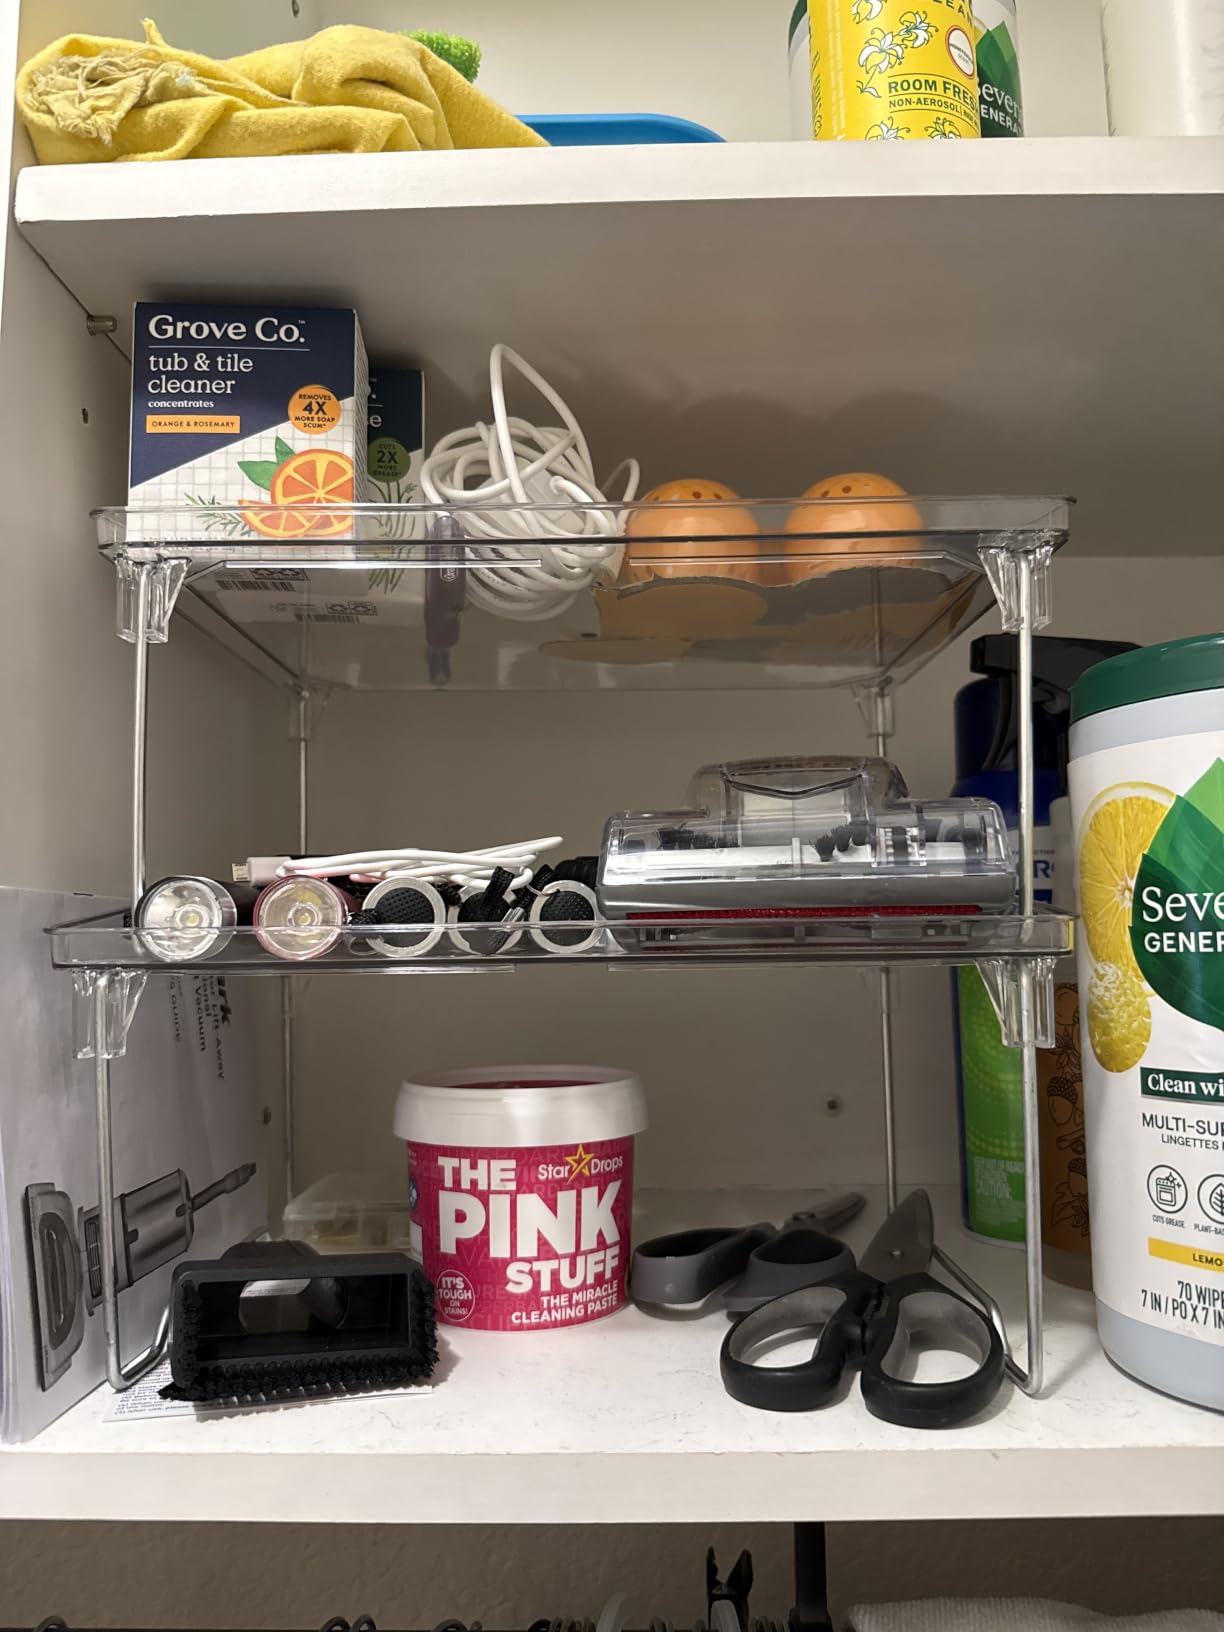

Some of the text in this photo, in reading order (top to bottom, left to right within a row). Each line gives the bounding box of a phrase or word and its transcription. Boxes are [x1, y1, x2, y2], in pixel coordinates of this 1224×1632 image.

[888, 79, 978, 113] ROOM FRES
[889, 98, 960, 113] NON-AEROSOL
[978, 77, 1021, 119] even
[981, 105, 1022, 136] ENERA
[149, 314, 247, 341] Grove
[149, 353, 254, 372] tub & tile
[148, 375, 236, 394] cleaner
[148, 400, 215, 408] concentrates
[298, 393, 332, 401] REMOVES
[302, 401, 328, 415] 4X
[376, 450, 399, 464] 2X
[1147, 1073, 1197, 1094] Clean
[1161, 1133, 1219, 1150] LINGETTES
[437, 1156, 517, 1191] THE
[538, 1156, 623, 1180] Star Drops
[438, 1180, 622, 1258] PINK
[1166, 1217, 1185, 1229] GREASE
[505, 1245, 620, 1294] STUFF
[1192, 1252, 1223, 1267] LEMO
[441, 1277, 464, 1289] IT'S
[1177, 1280, 1192, 1301] 70
[439, 1289, 472, 1300] TOUGH
[541, 1280, 618, 1308] THE MIRACLE
[511, 1305, 584, 1324] CLEANING
[587, 1293, 618, 1314] PASTE
[1141, 1289, 1148, 1307] 7
[1150, 1292, 1162, 1312] IN
[1171, 1298, 1188, 1320] PO
[1190, 1303, 1200, 1323] X
[1201, 1307, 1209, 1326] 7
